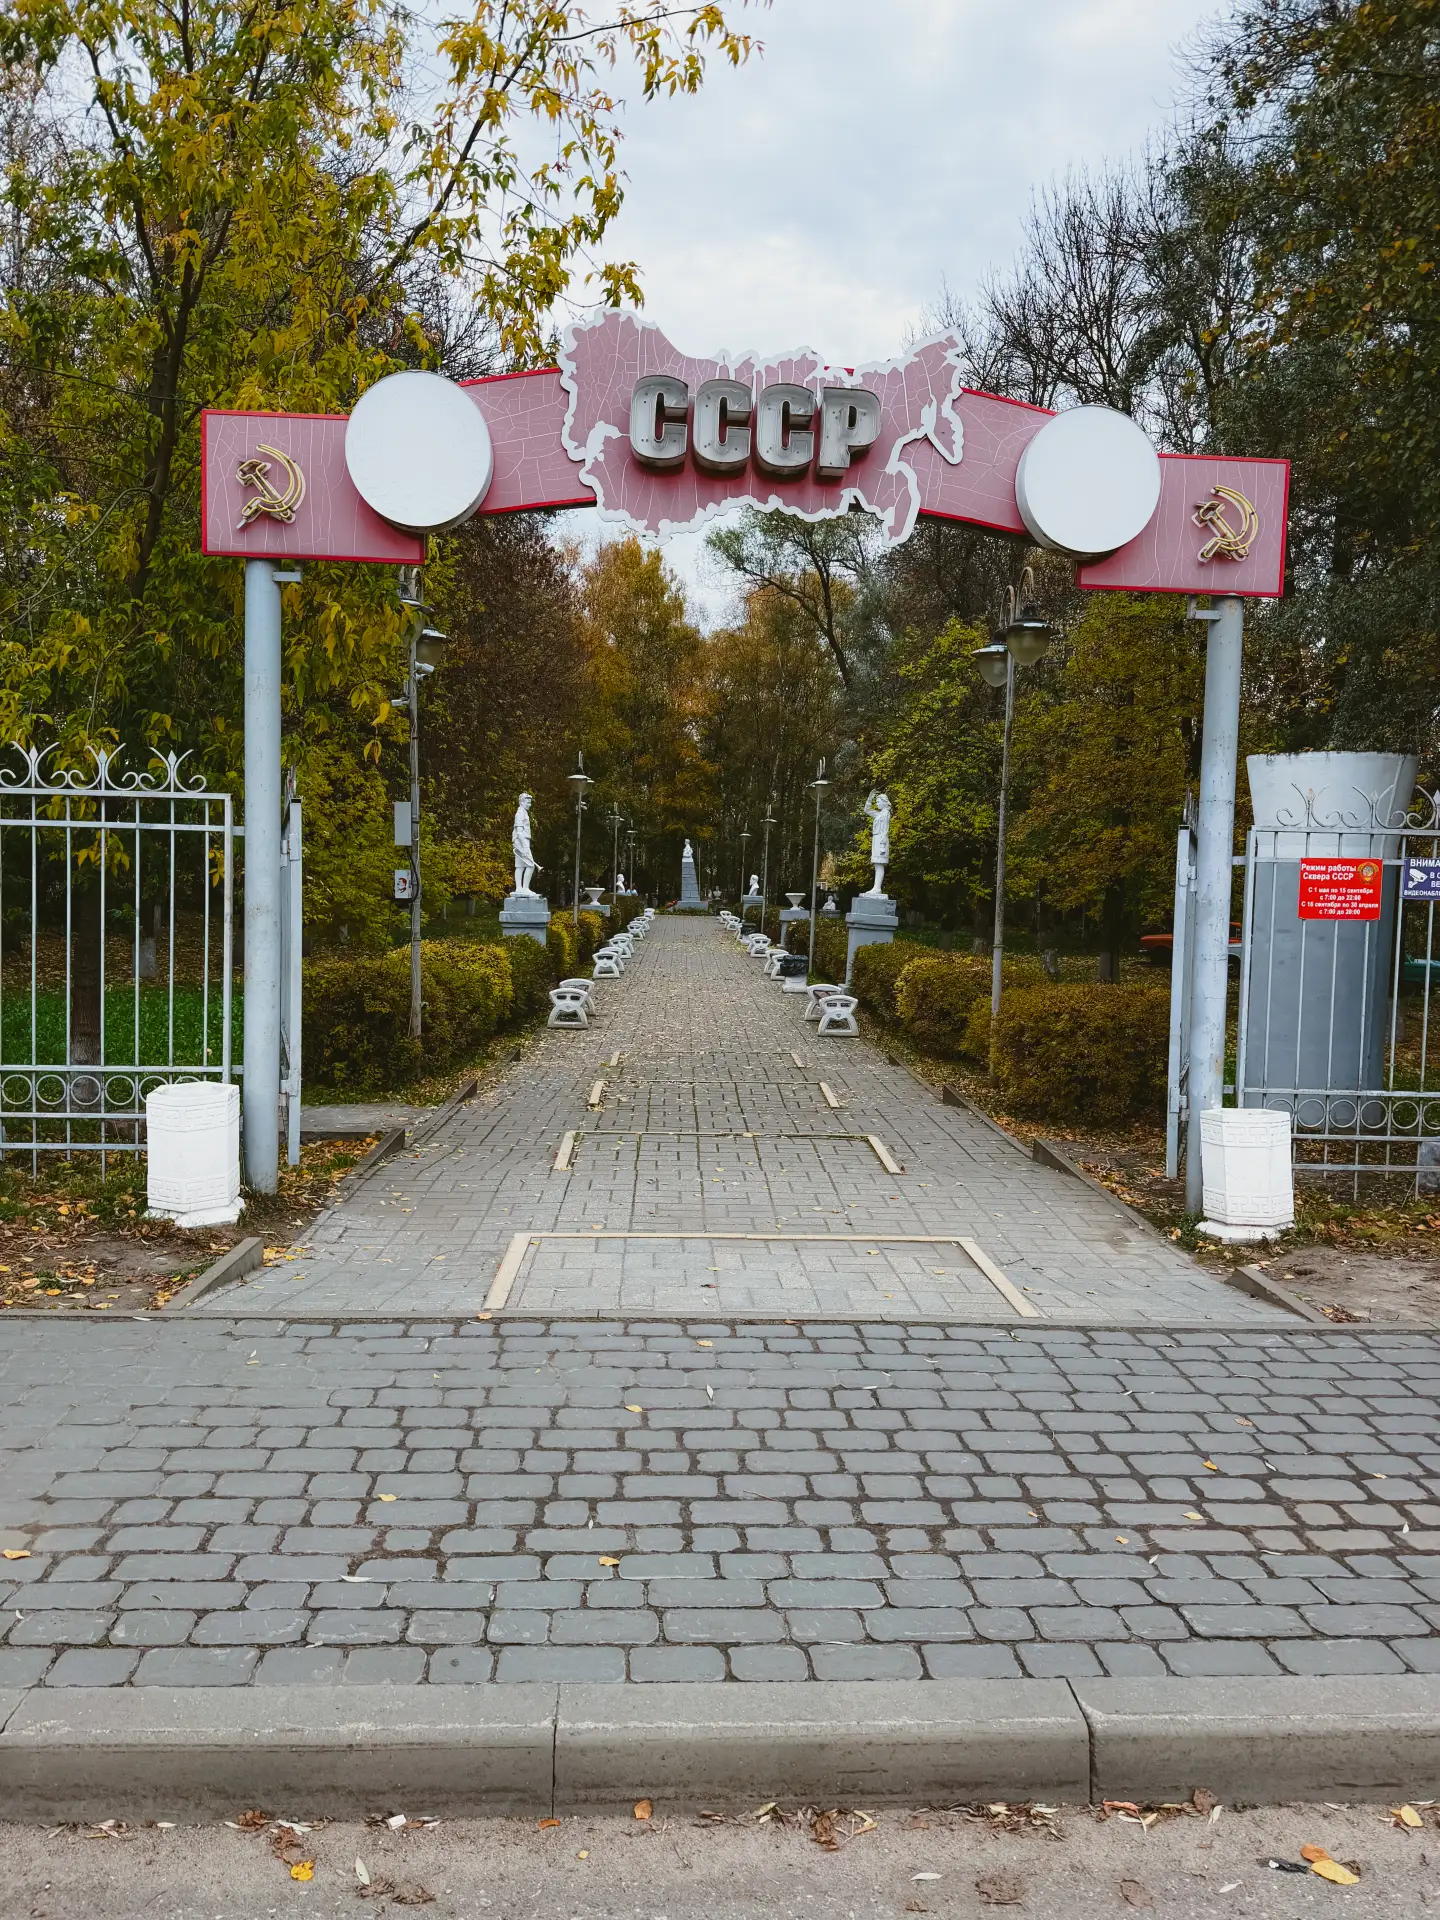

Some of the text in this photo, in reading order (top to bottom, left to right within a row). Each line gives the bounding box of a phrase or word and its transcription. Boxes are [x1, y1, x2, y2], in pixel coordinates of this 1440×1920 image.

[630, 374, 881, 478] СССР
[1328, 864, 1356, 872] работы
[1303, 872, 1330, 881] Сквера
